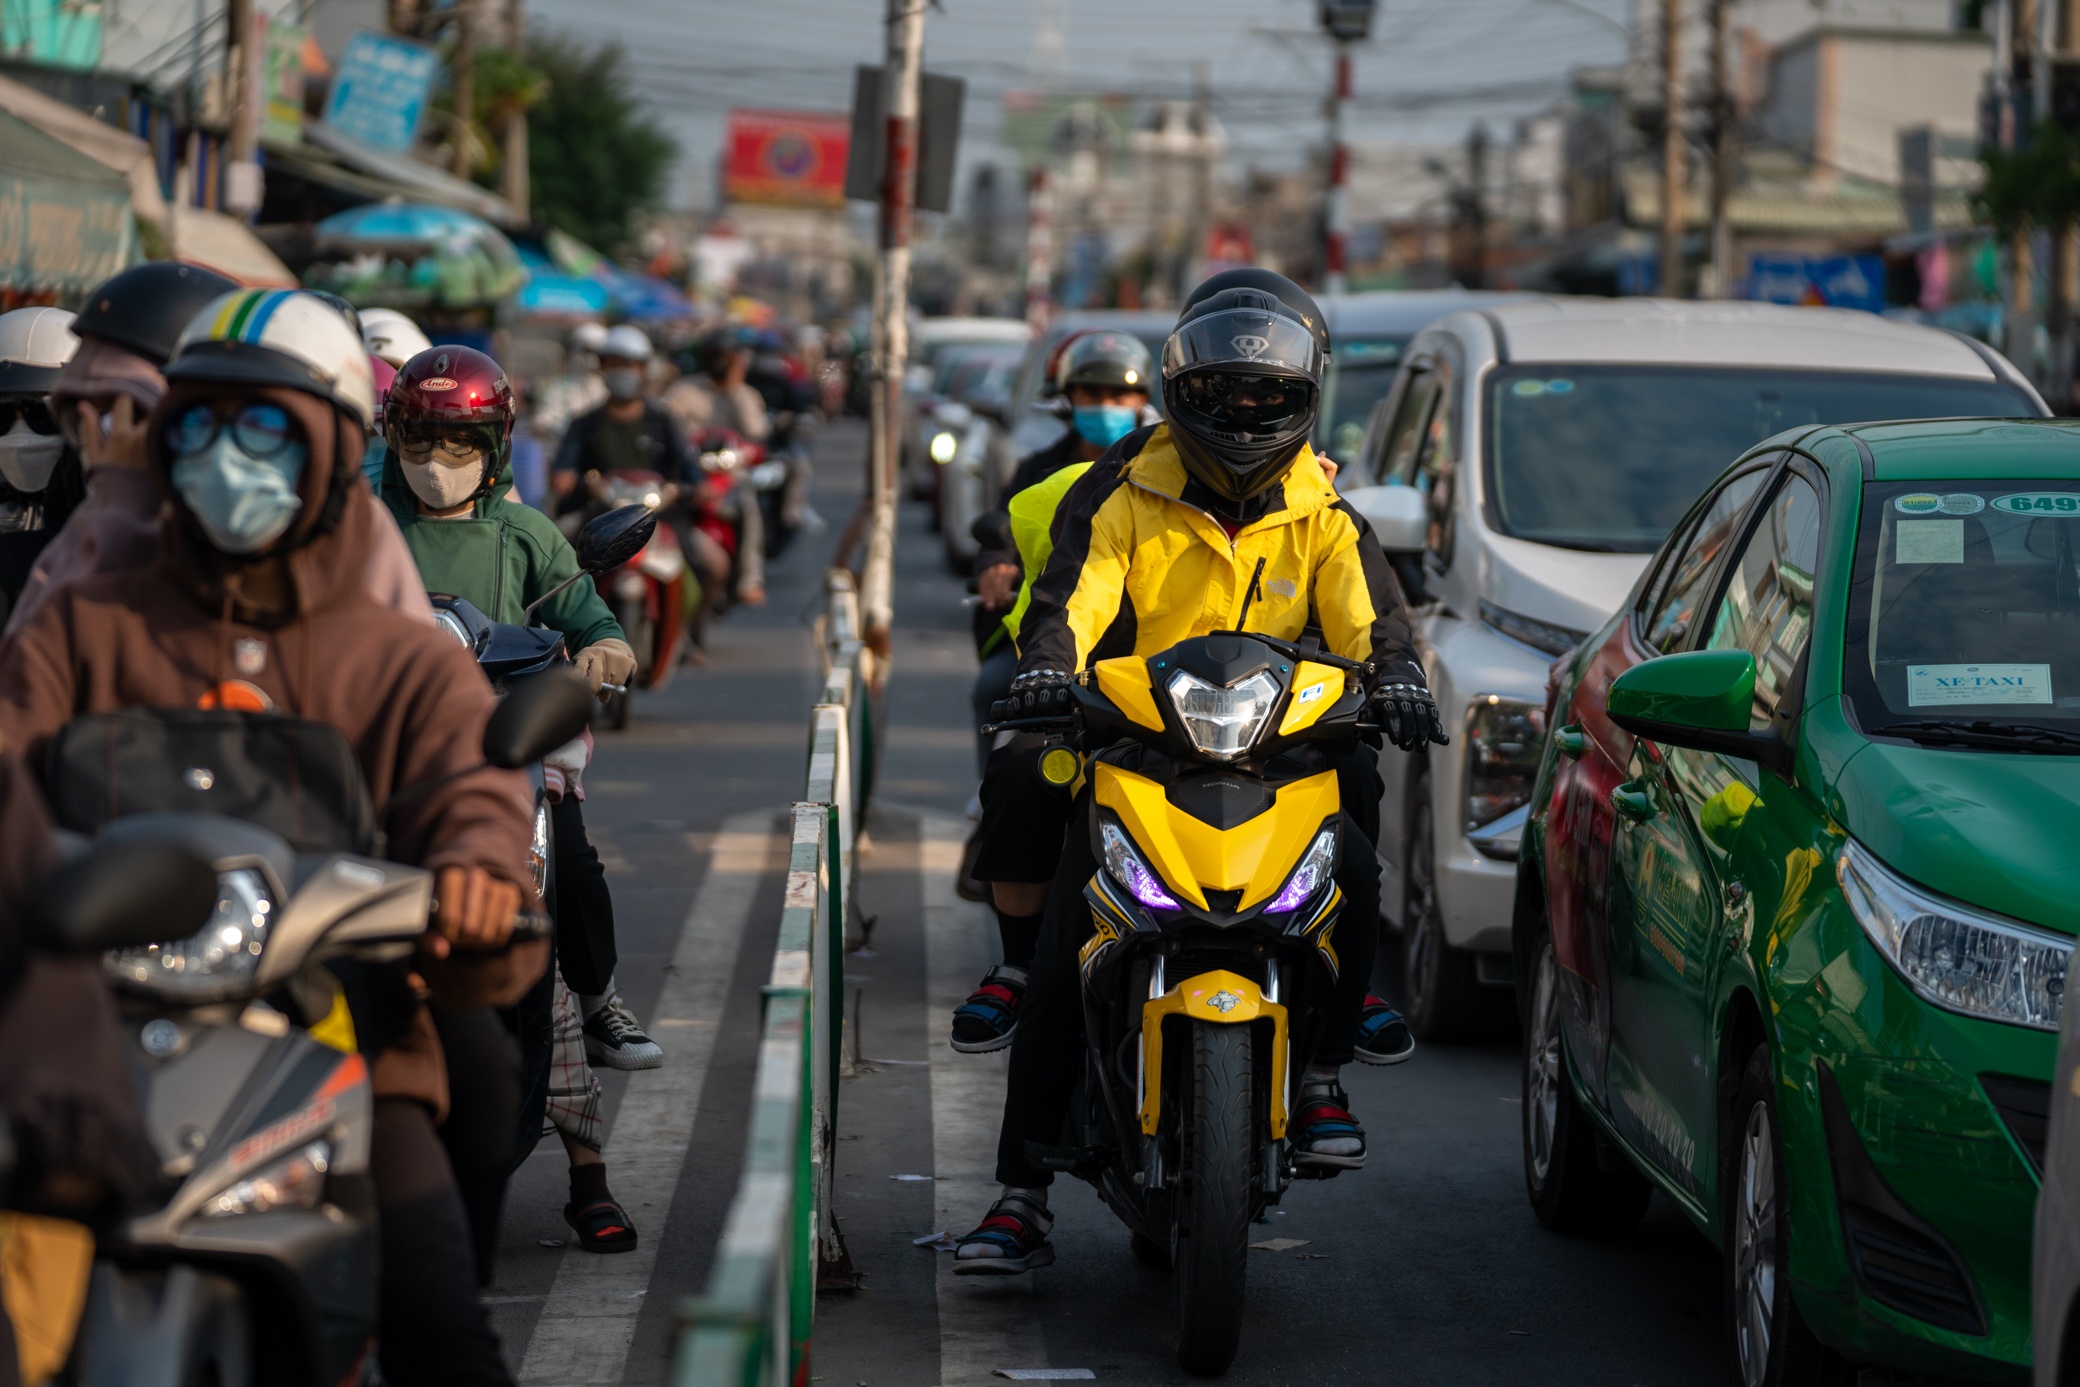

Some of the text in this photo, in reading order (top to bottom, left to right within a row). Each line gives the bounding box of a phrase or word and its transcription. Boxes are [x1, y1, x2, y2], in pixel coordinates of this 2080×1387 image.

[2010, 497, 2080, 511] 649
[1936, 677, 2023, 687] XE TAXI
[1202, 781, 1240, 790] HONDA
